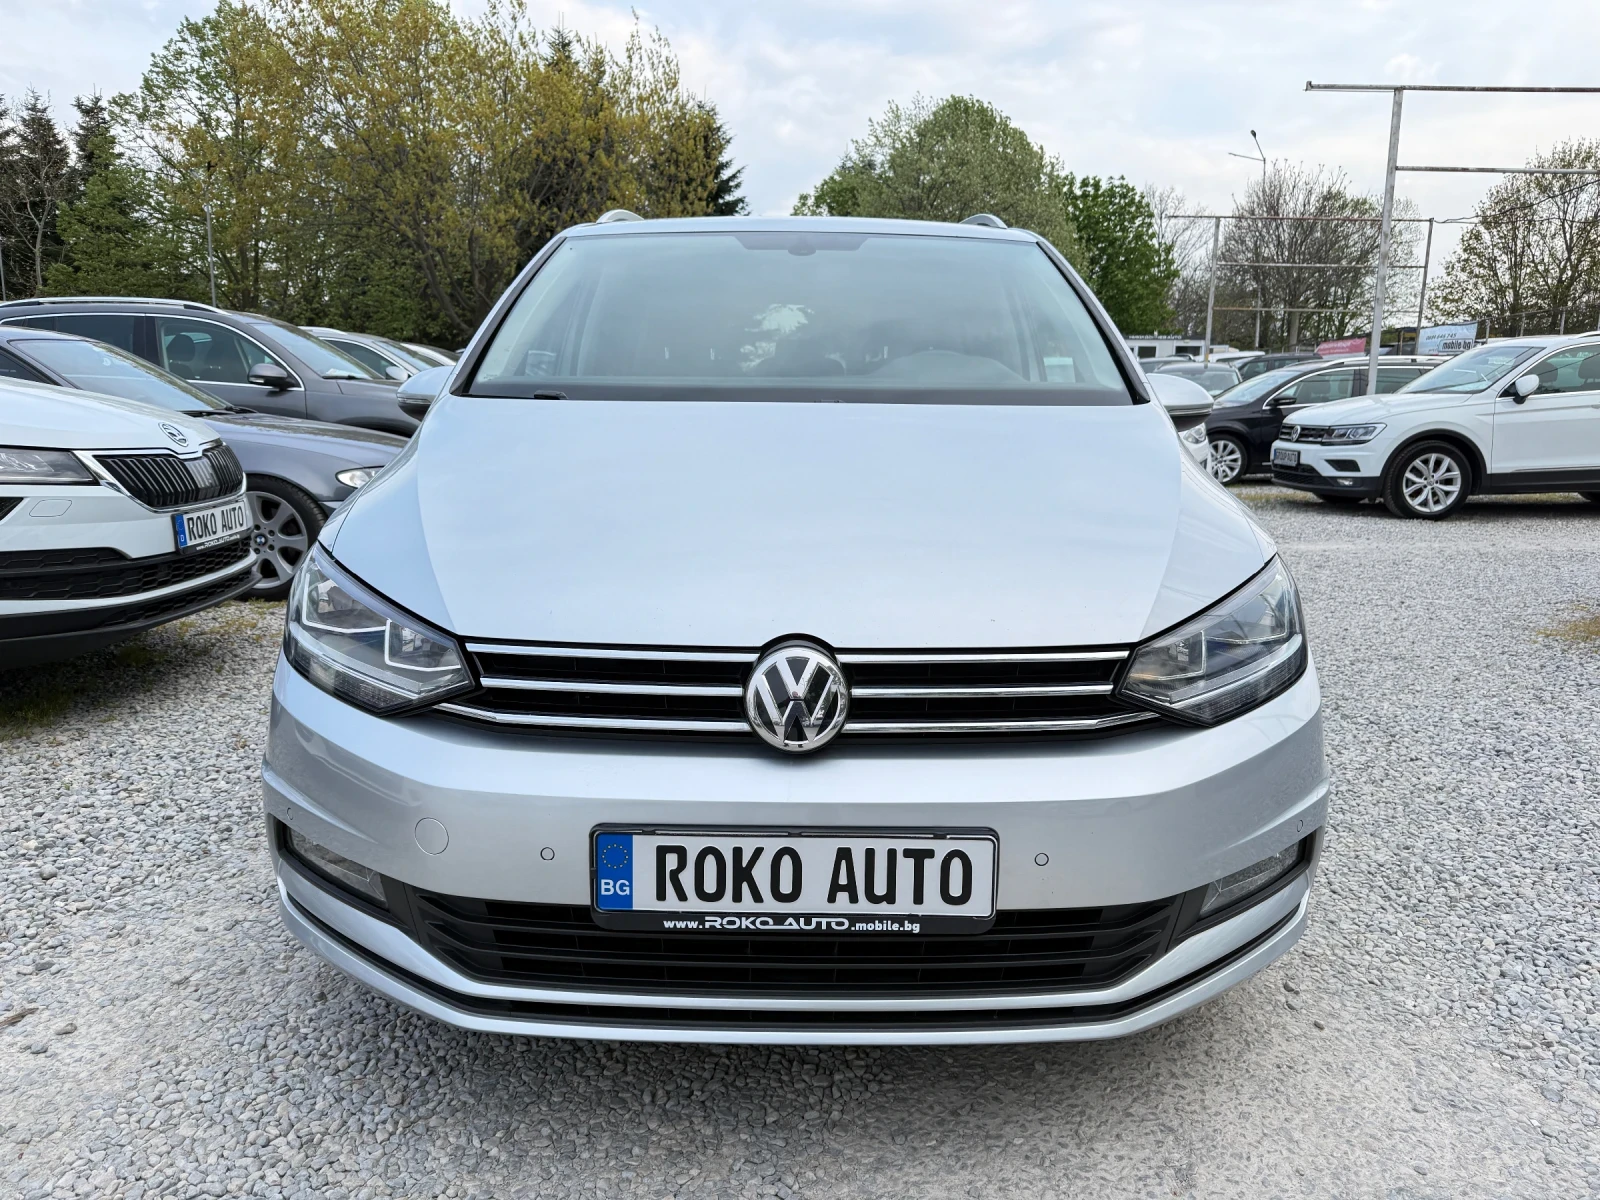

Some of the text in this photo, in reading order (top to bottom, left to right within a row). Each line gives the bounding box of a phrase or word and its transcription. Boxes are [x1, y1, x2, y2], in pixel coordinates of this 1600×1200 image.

[1442, 340, 1472, 350] mobilebg
[186, 505, 244, 541] ROKO AUTO
[600, 879, 630, 896] BG
[655, 844, 973, 906] ROKO AUTO
